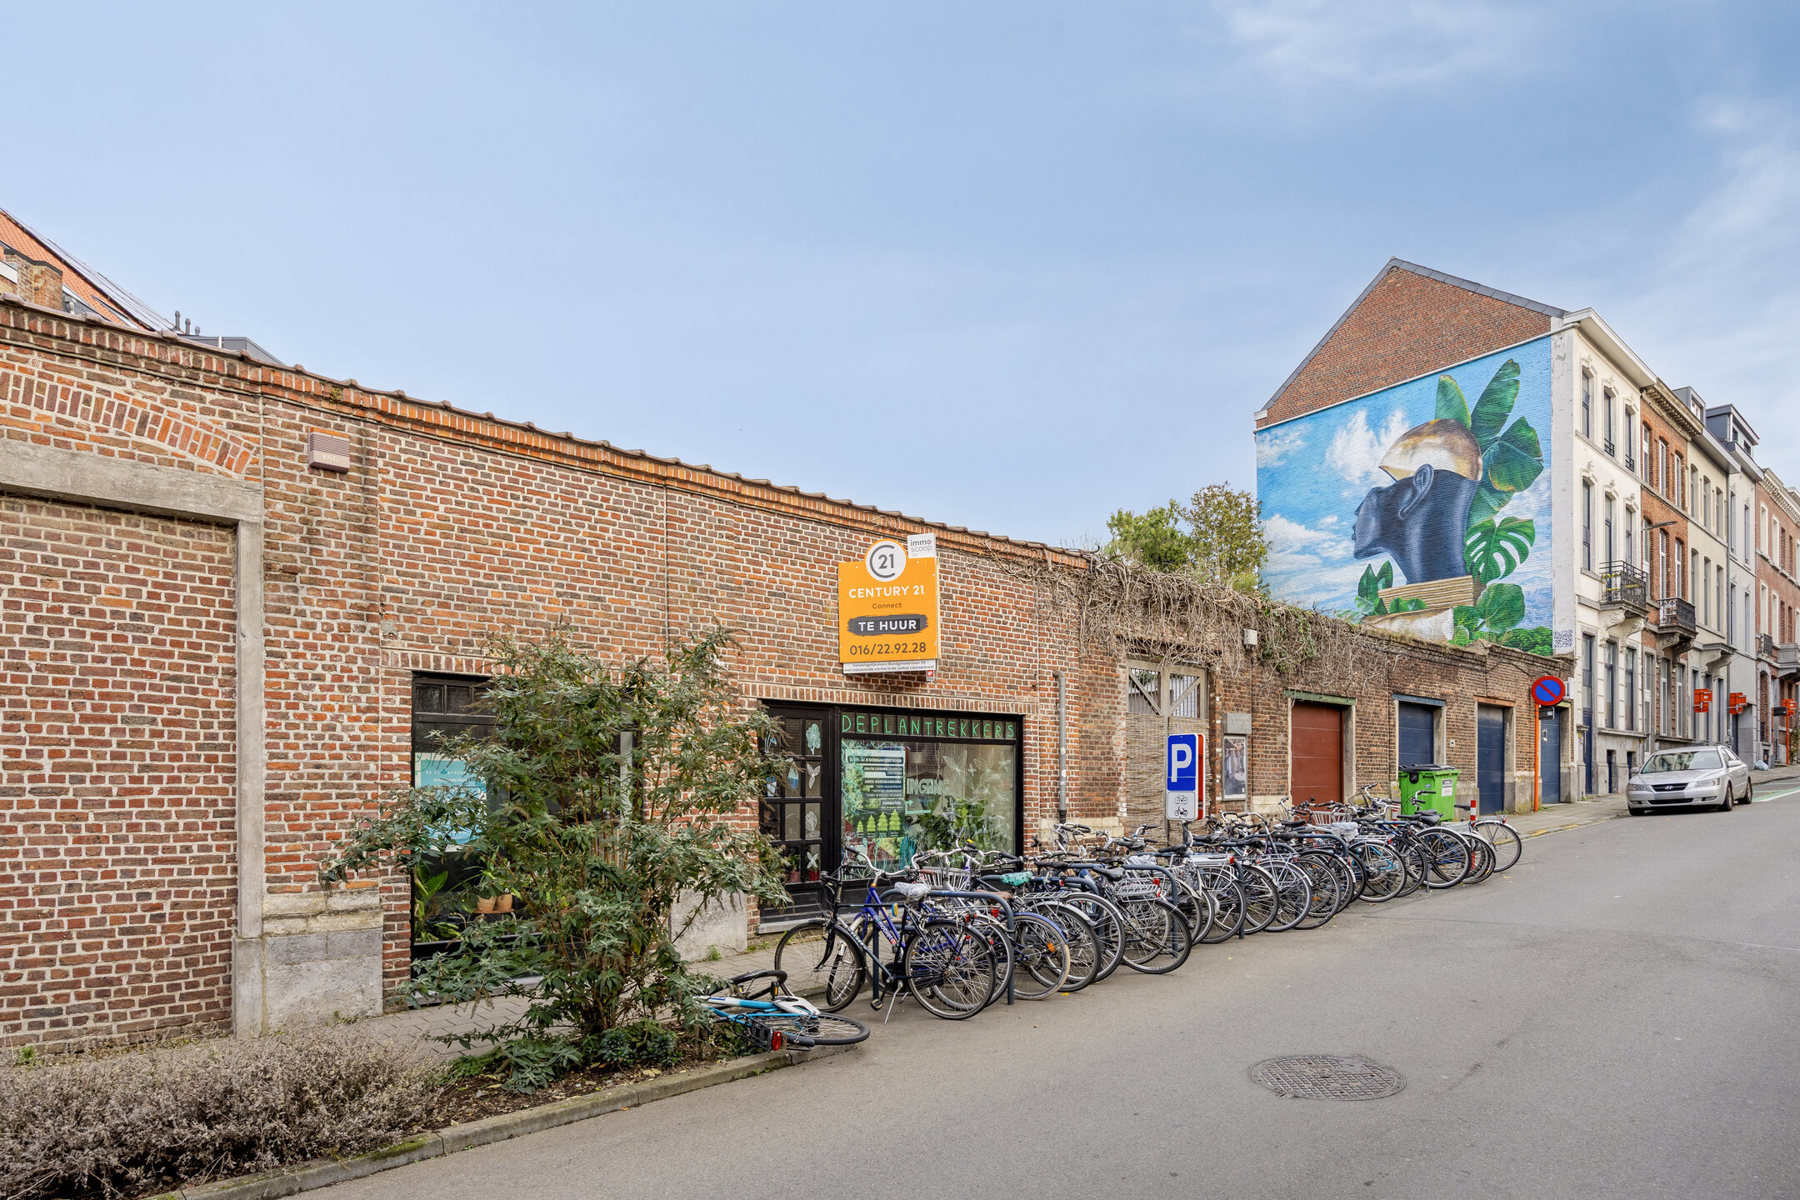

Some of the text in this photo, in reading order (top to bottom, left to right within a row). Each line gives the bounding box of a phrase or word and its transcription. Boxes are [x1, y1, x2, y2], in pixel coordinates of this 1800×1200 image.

[848, 584, 925, 599] CENTURY 21
[871, 602, 902, 610] Connect
[858, 619, 917, 632] TE HUUR
[850, 642, 927, 656] 016/22.92.28
[1171, 743, 1193, 783] P
